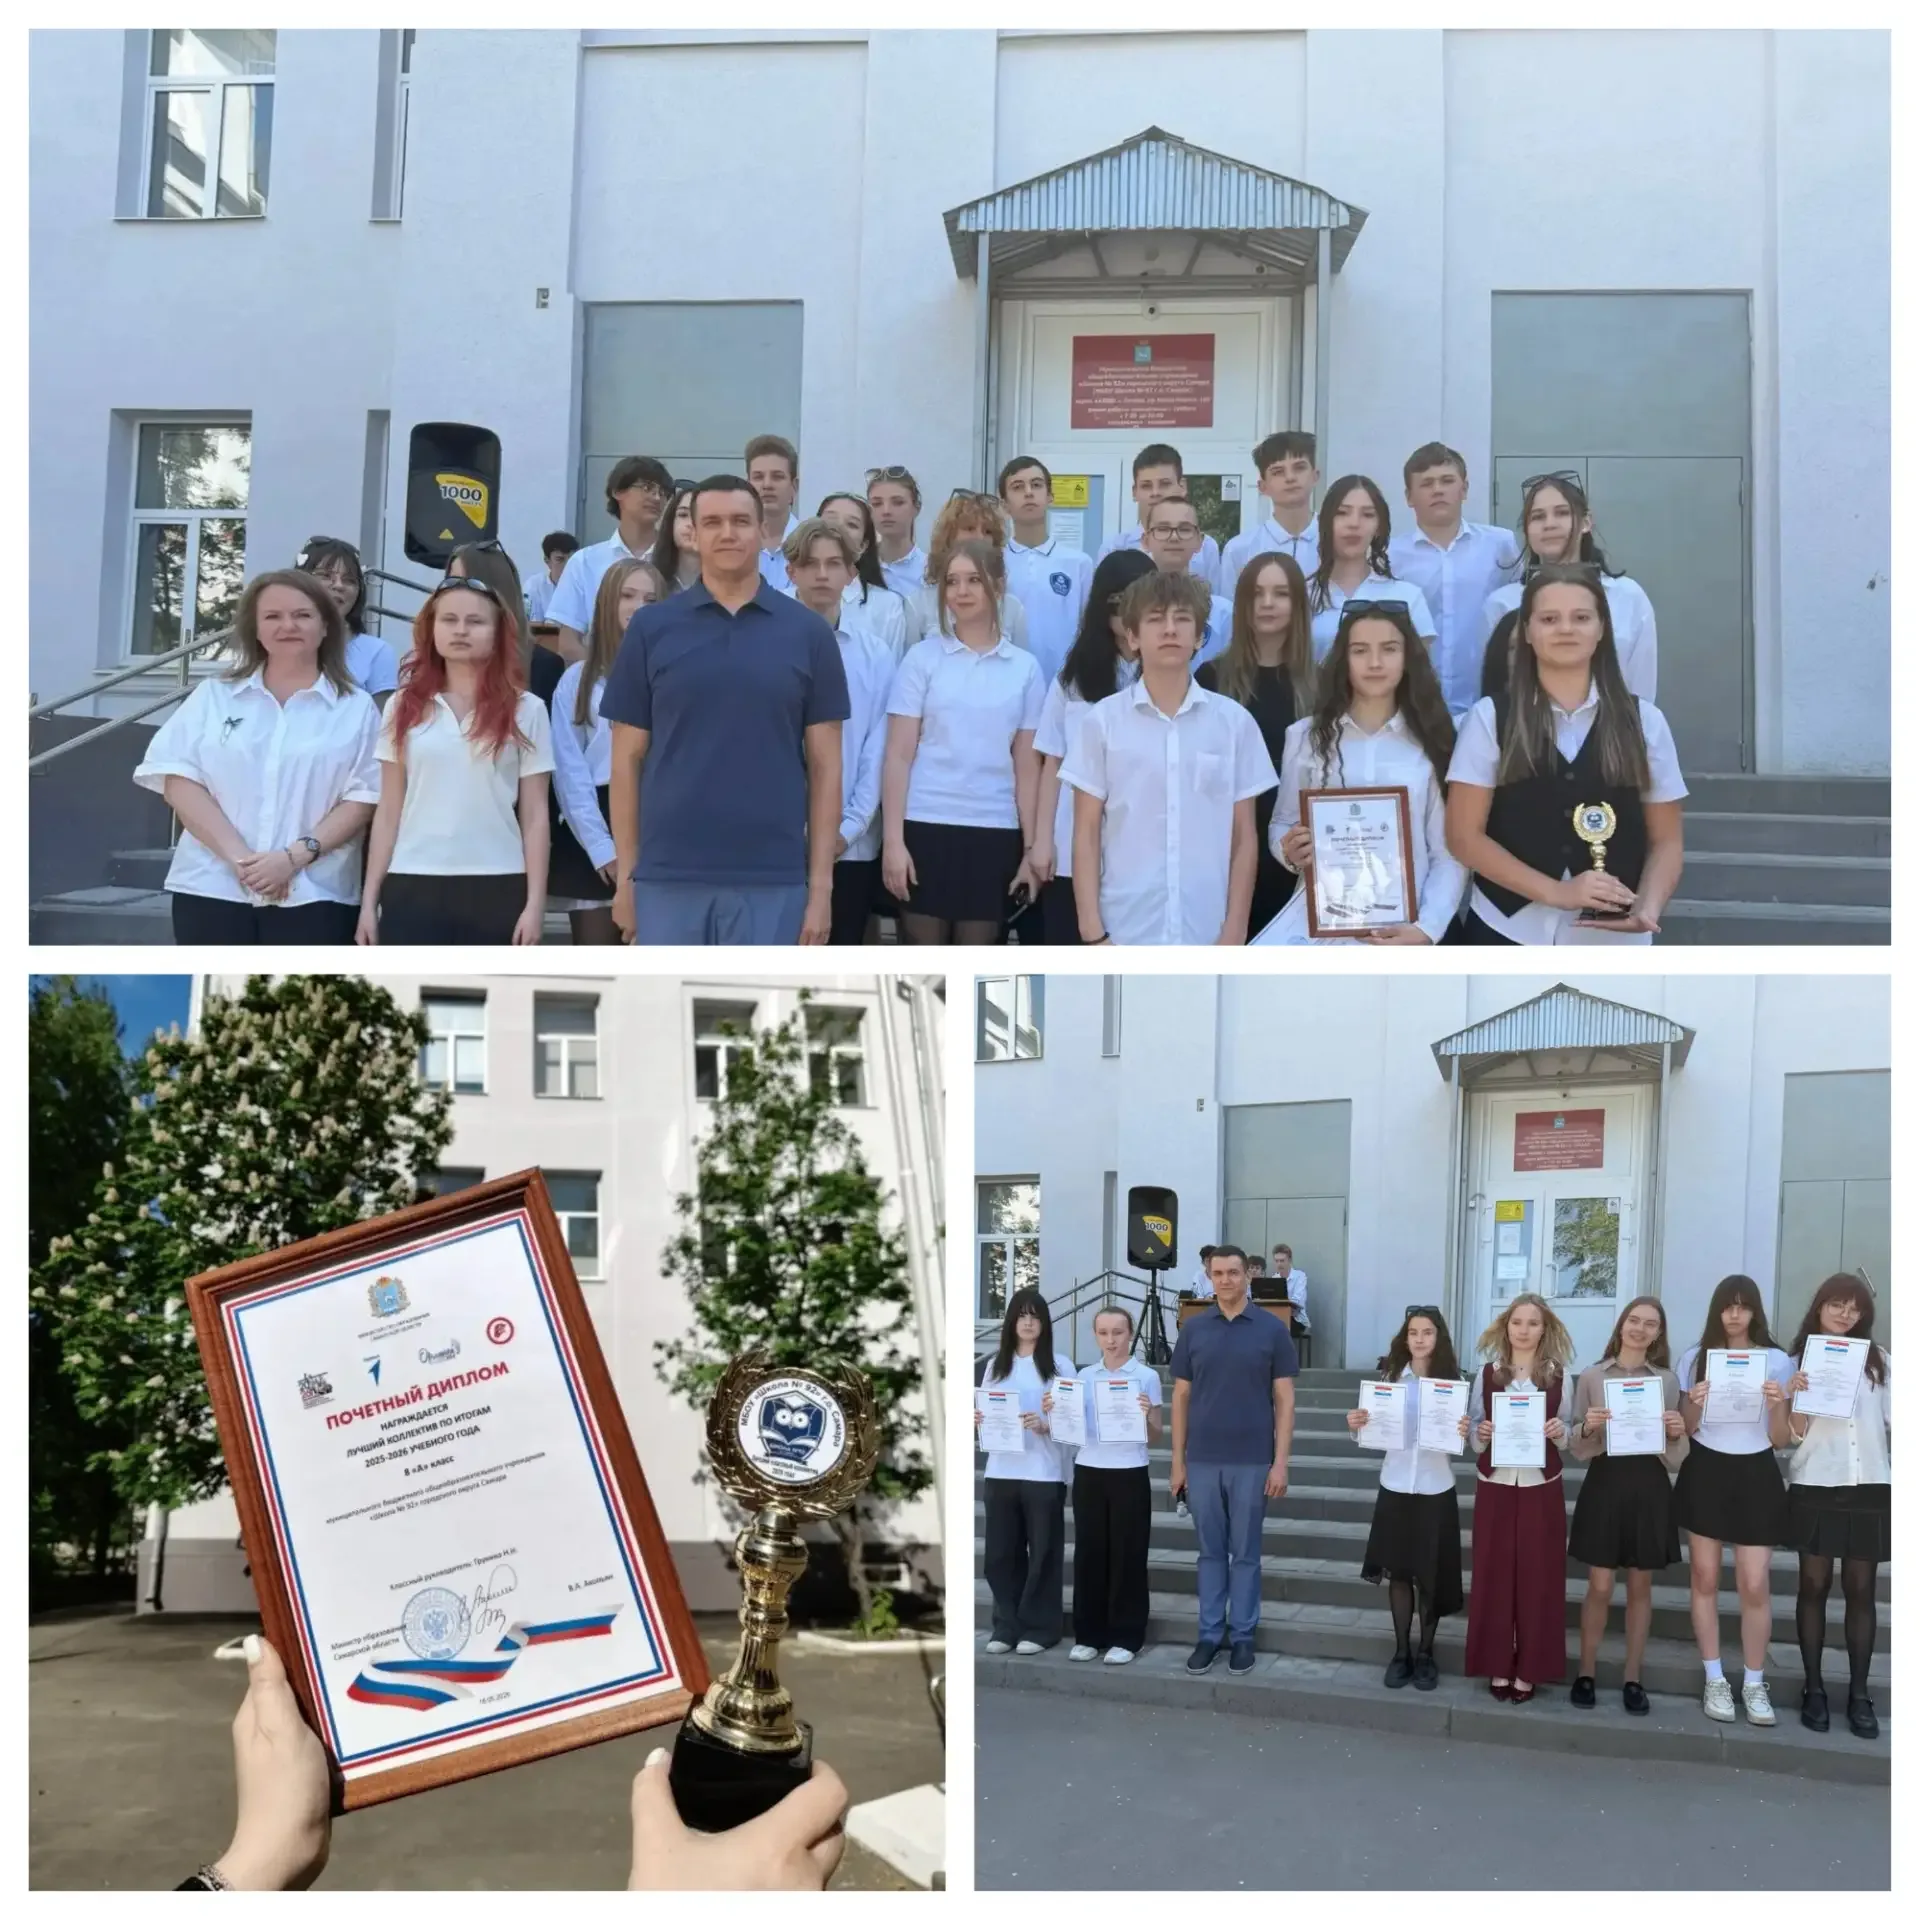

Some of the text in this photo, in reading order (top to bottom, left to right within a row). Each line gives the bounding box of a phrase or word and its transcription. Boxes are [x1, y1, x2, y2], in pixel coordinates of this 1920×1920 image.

[441, 486, 482, 501] 1000
[1145, 1222, 1168, 1232] 1000
[326, 1385, 423, 1429] ПОЧЕТНЫЙ
[427, 1361, 509, 1400] ДИПЛОМ
[346, 1405, 491, 1458] ЛУЧШИЙ КОЛЛЕКТИВ ПО ИТОГАМ
[380, 1403, 448, 1431] НАГРАЖДАЕТСЯ
[740, 1400, 755, 1426] МБОУ
[754, 1381, 789, 1400] «Школа
[804, 1383, 821, 1397] 92»
[831, 1410, 843, 1447] Самара
[364, 1424, 481, 1468] 2025-2026 УЧЕБНОГО ГОДА
[403, 1455, 455, 1477] 8 «А» класс
